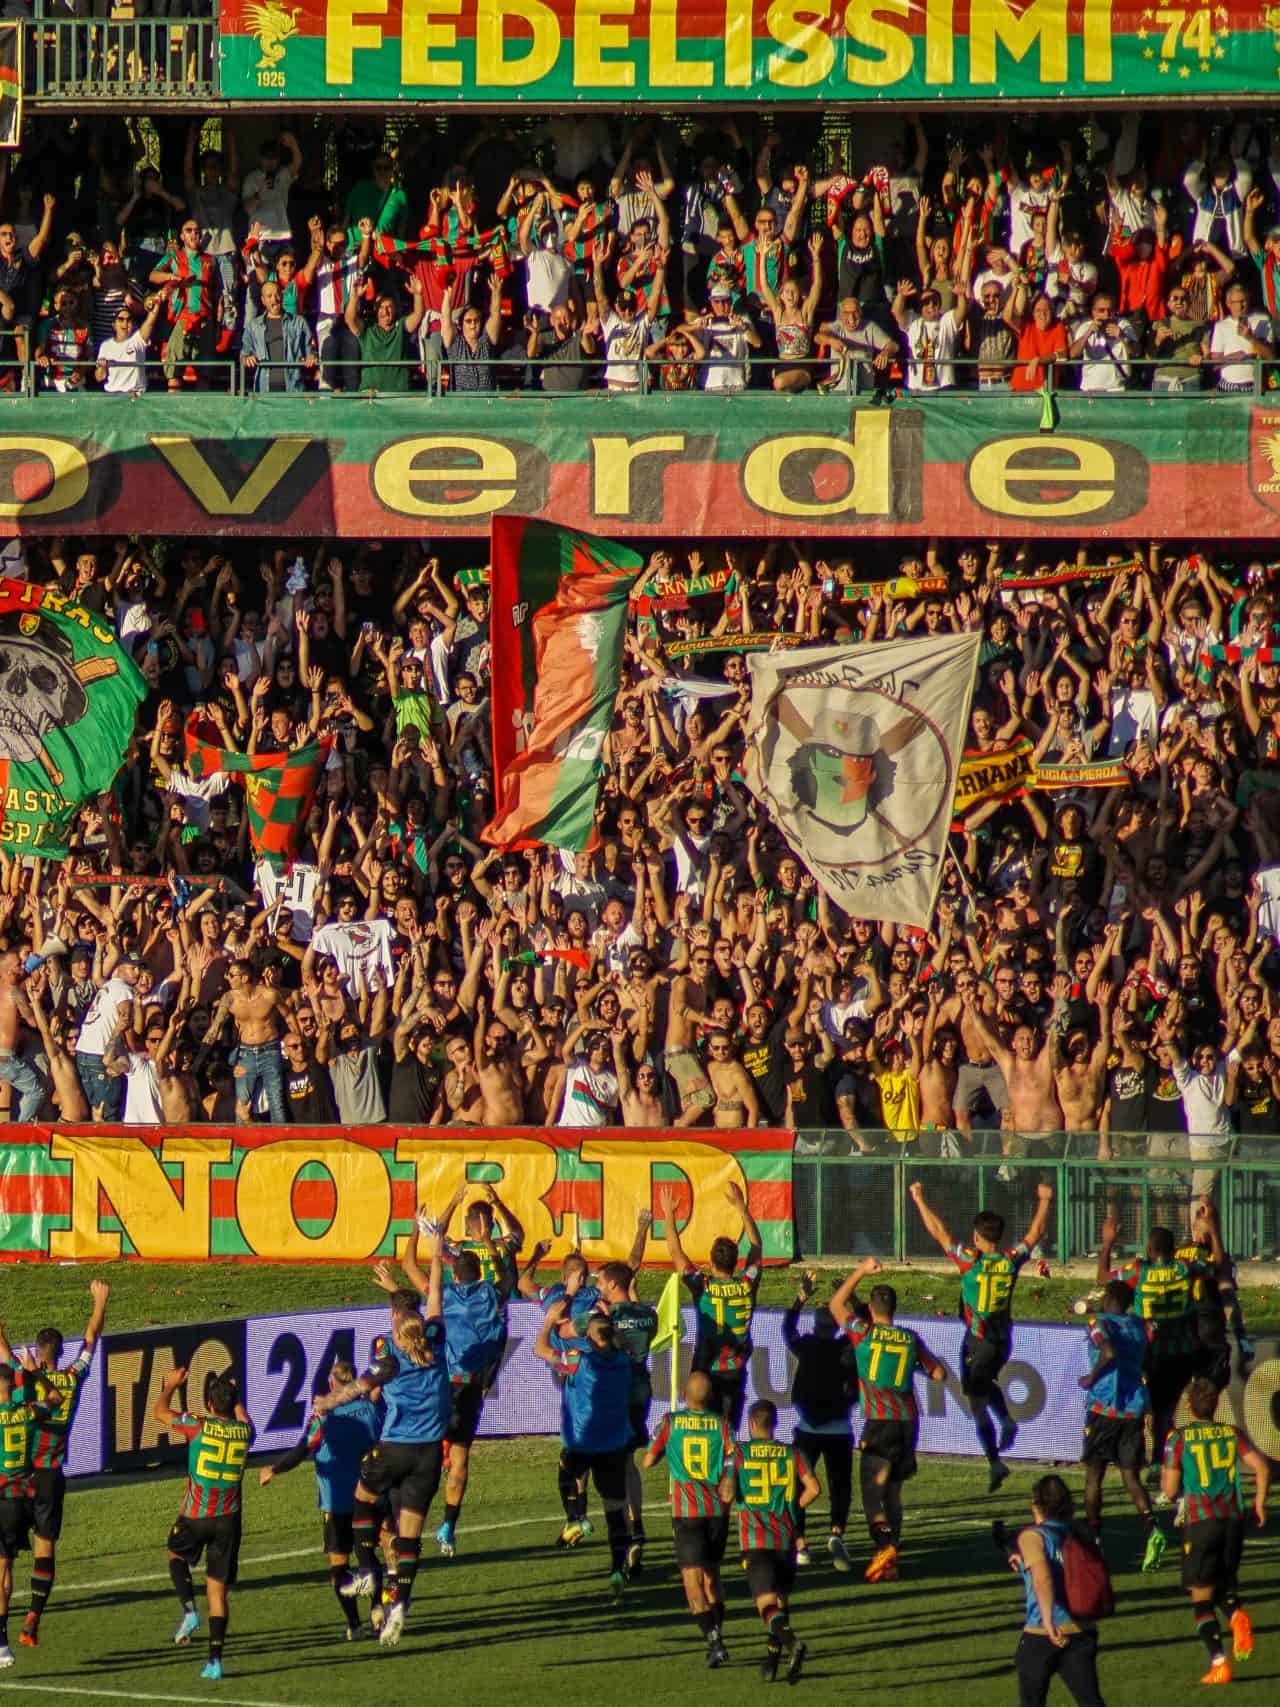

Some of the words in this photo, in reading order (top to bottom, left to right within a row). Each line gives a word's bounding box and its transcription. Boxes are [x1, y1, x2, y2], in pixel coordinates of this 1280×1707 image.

[326, 0, 1112, 88] FEDELISSIMI
[1156, 9, 1215, 58] 74
[256, 72, 286, 87] 1925
[49, 1134, 748, 1261] NORD
[868, 1343, 908, 1387] 17
[3, 1426, 27, 1469] 9
[196, 1435, 247, 1481] 25
[683, 1436, 708, 1480] 8
[1190, 1440, 1236, 1488] 14
[743, 1460, 795, 1505] 34
